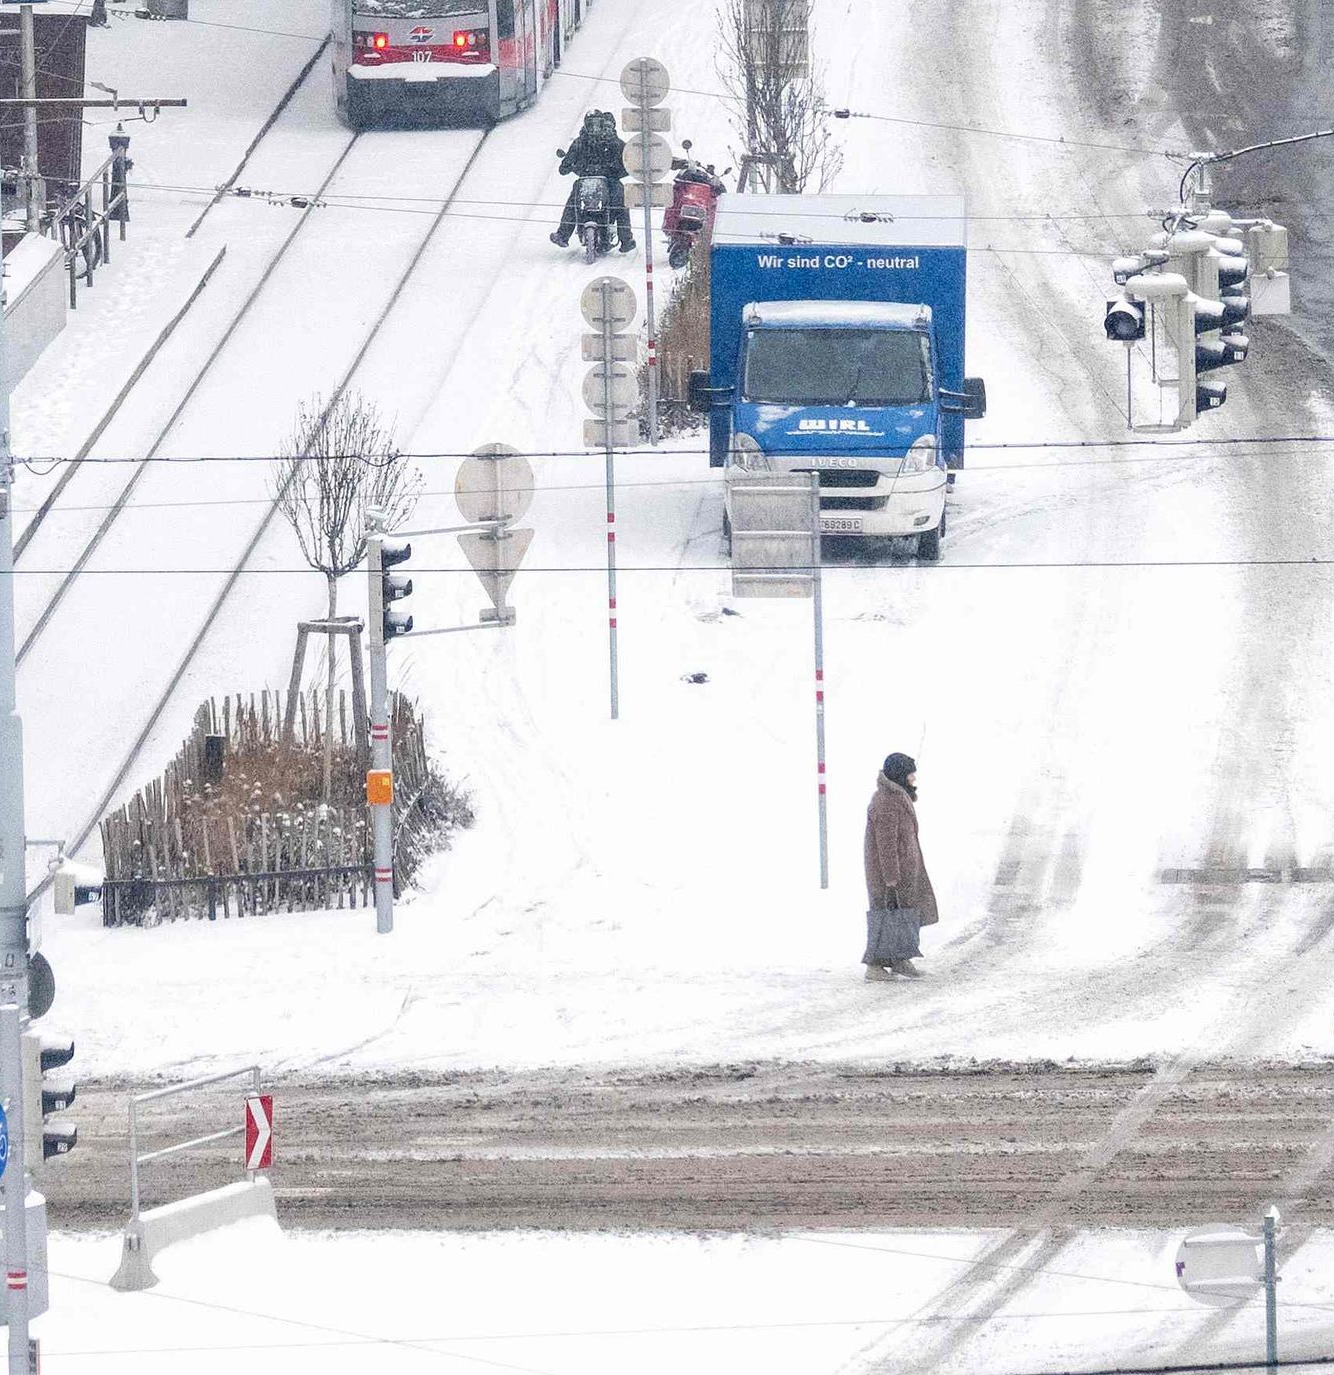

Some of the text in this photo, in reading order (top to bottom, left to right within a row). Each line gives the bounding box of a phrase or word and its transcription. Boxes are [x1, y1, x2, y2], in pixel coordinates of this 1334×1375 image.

[412, 50, 433, 63] 107
[758, 255, 784, 269] Wir
[787, 255, 820, 269] sind
[867, 255, 919, 269] neutral
[810, 458, 858, 467] IVECO
